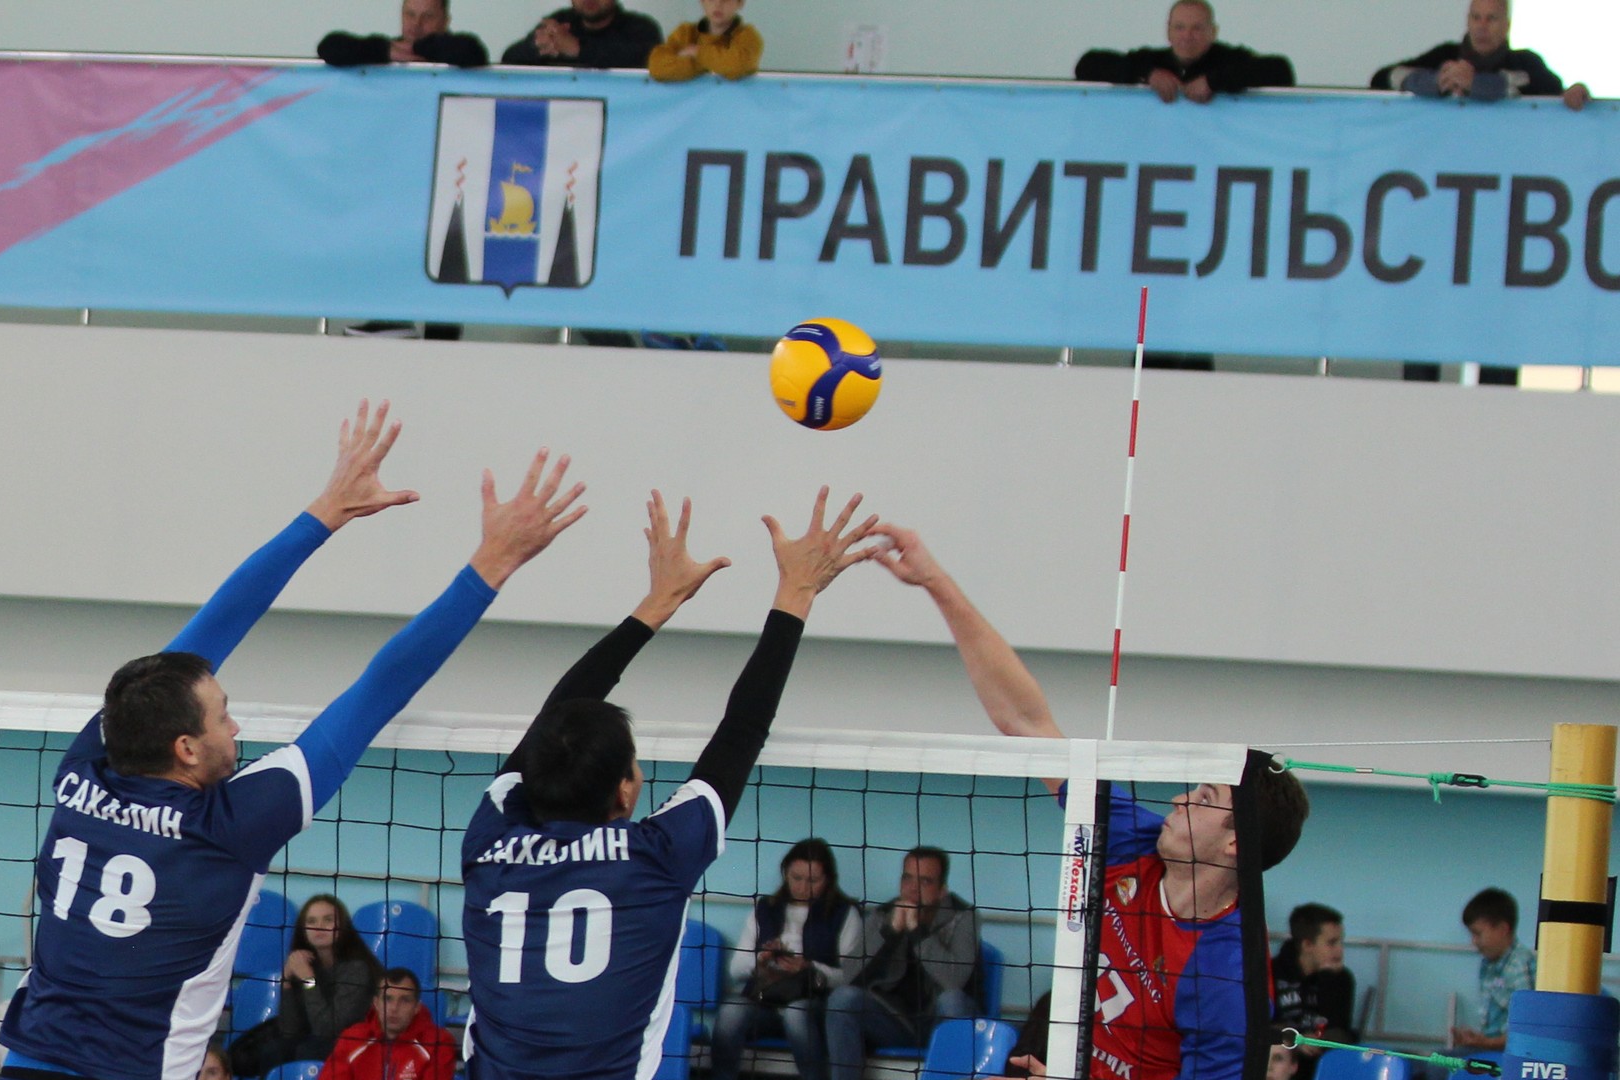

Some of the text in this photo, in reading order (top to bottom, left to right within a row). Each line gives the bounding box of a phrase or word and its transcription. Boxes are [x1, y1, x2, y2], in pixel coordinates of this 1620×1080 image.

[679, 148, 1620, 292] ПРАВИТЕЛЬСТВО
[56, 771, 184, 840] САХАЛИН
[51, 836, 157, 939] 18
[485, 888, 614, 984] 10
[1521, 1062, 1567, 1080] FIVB
